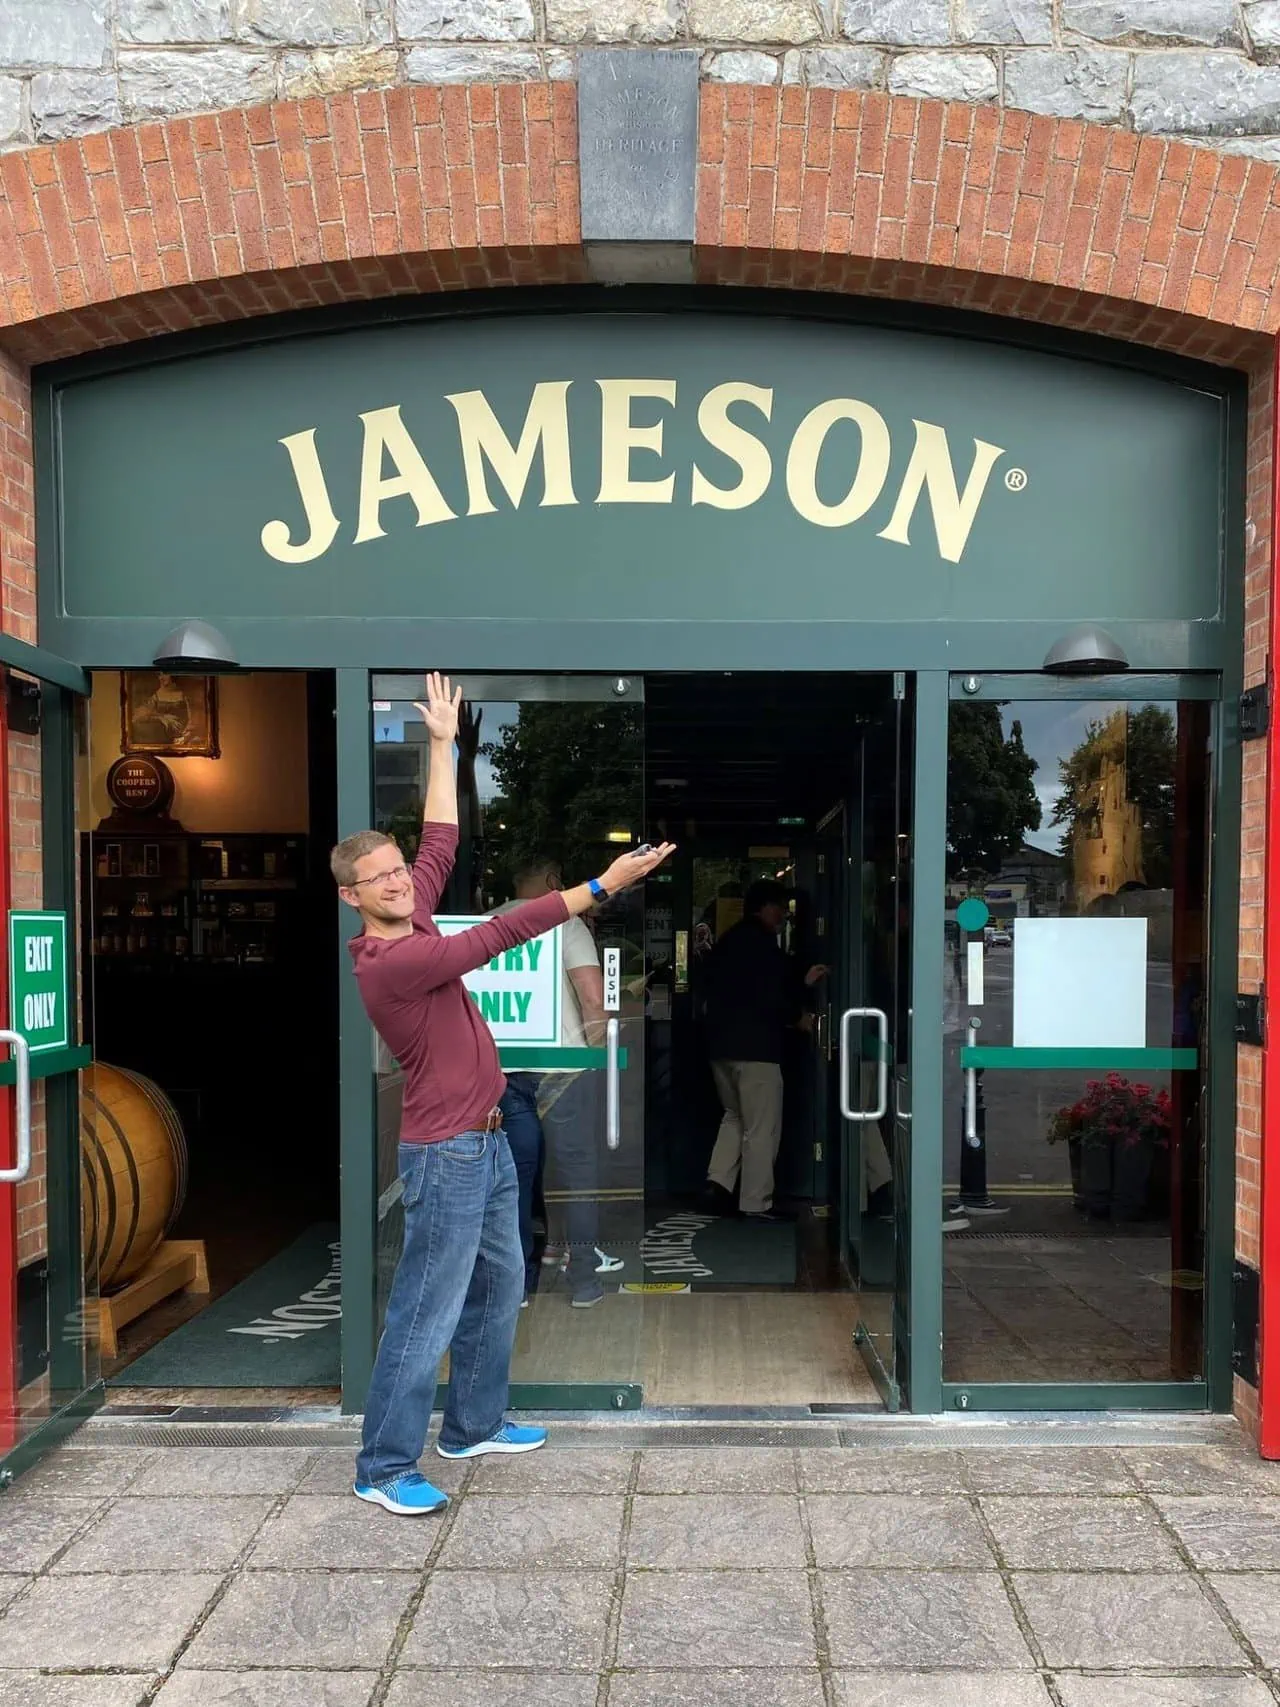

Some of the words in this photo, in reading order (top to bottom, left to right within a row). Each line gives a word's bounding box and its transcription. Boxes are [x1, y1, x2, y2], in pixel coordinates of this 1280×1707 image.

[596, 139, 683, 153] HERITAGE
[116, 778, 156, 786] COOPERS
[127, 769, 145, 777] THE
[24, 936, 54, 972] EXIT
[607, 953, 617, 1004] PUSH
[23, 992, 56, 1031] ONLY
